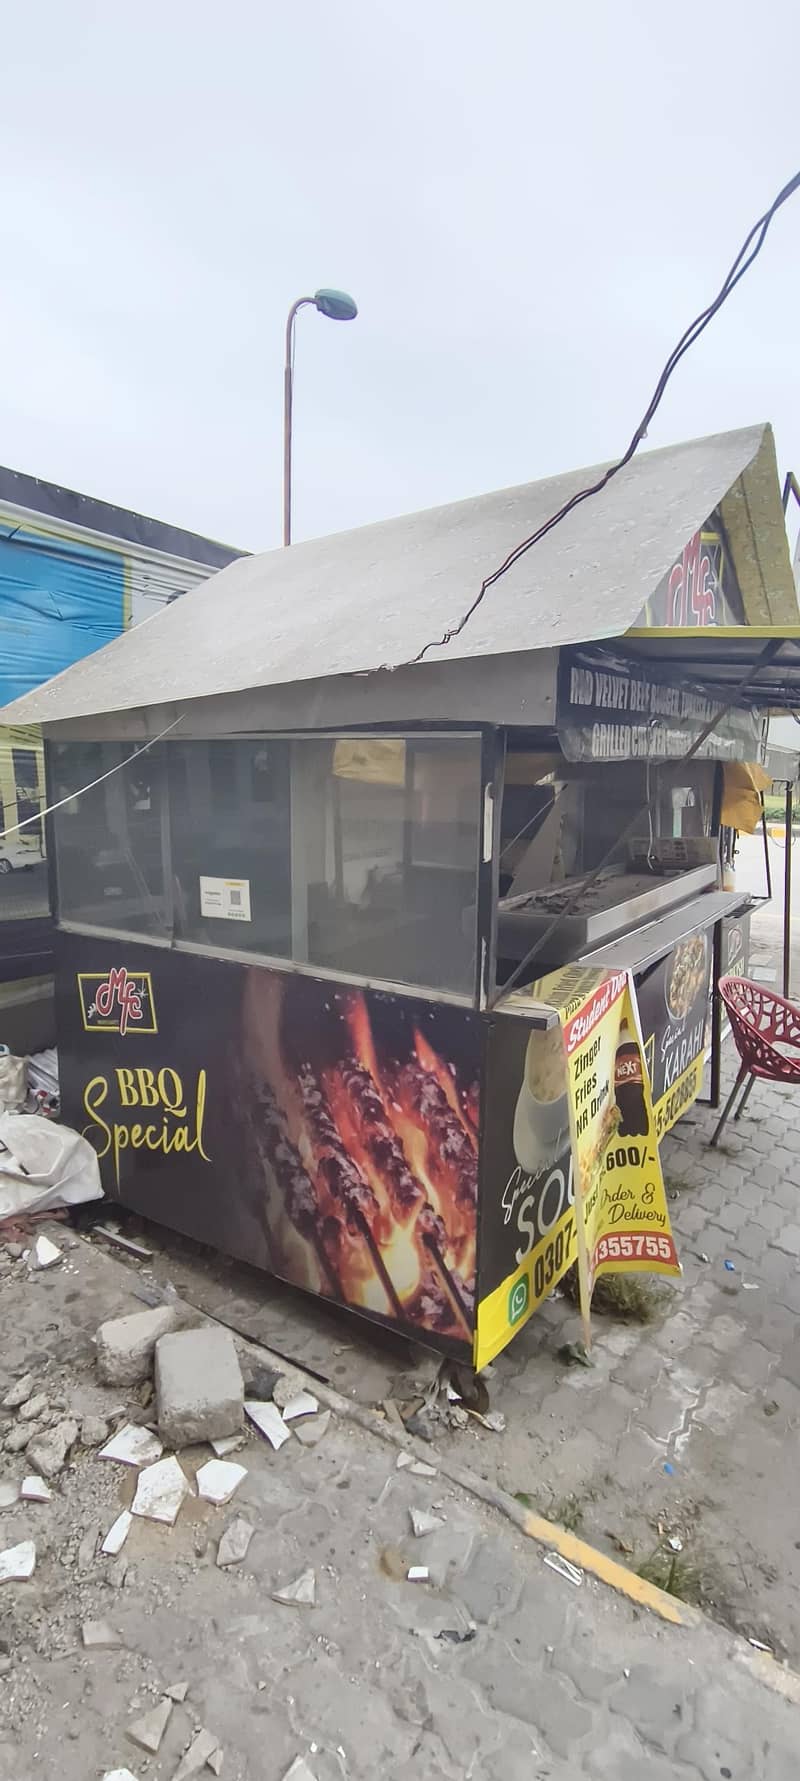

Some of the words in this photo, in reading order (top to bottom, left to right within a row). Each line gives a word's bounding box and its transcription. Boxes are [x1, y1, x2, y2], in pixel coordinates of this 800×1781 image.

[595, 671, 629, 710] VELVET
[592, 722, 631, 757] GRILLED
[567, 983, 610, 1052] Student
[574, 1036, 601, 1080] Zinger
[115, 1067, 187, 1118] BBQ
[575, 1073, 597, 1110] Fries
[81, 1069, 211, 1195] Special
[576, 1109, 589, 1139] NR
[606, 1146, 655, 1171] 600/-
[641, 1182, 655, 1204] &
[608, 1203, 666, 1227] Delivery
